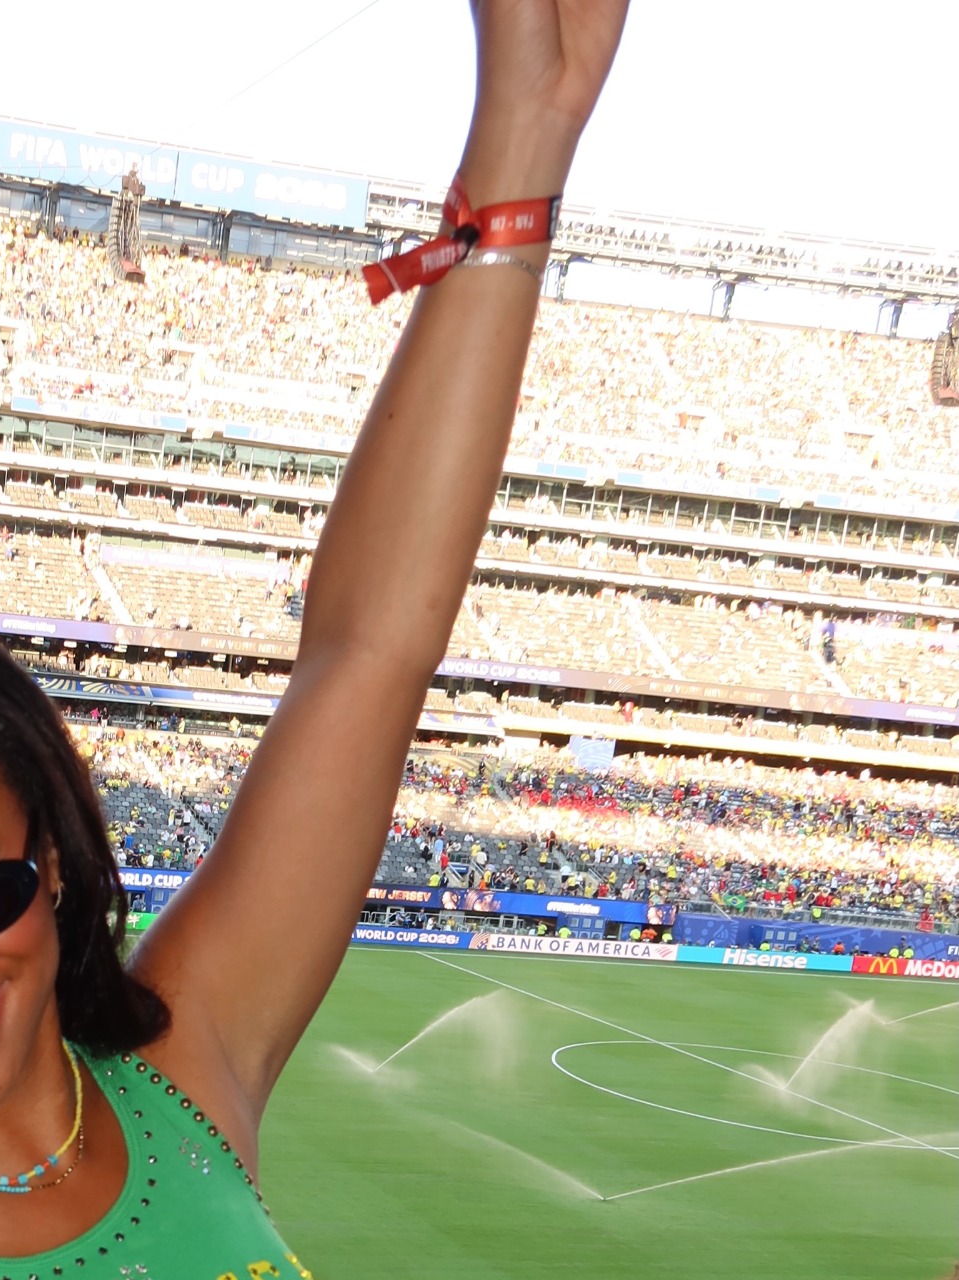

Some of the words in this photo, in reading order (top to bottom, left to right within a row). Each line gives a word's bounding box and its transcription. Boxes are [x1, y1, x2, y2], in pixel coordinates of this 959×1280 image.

[10, 133, 67, 168] FIFA
[191, 163, 245, 194] CUP
[200, 637, 226, 649] NEW
[258, 643, 283, 656] NEW
[443, 660, 490, 676] WORLD
[490, 665, 516, 678] CUP
[119, 873, 152, 886] ORLD
[154, 874, 183, 887] CUP
[366, 888, 387, 899] EW
[388, 890, 432, 902] JERSEY
[356, 928, 395, 941] WORLD
[396, 931, 418, 942] CUP
[418, 933, 457, 945] 2026
[496, 937, 543, 951] BANK
[549, 939, 570, 952] OF
[577, 942, 651, 957] AMERICA
[722, 948, 808, 970] Hisense
